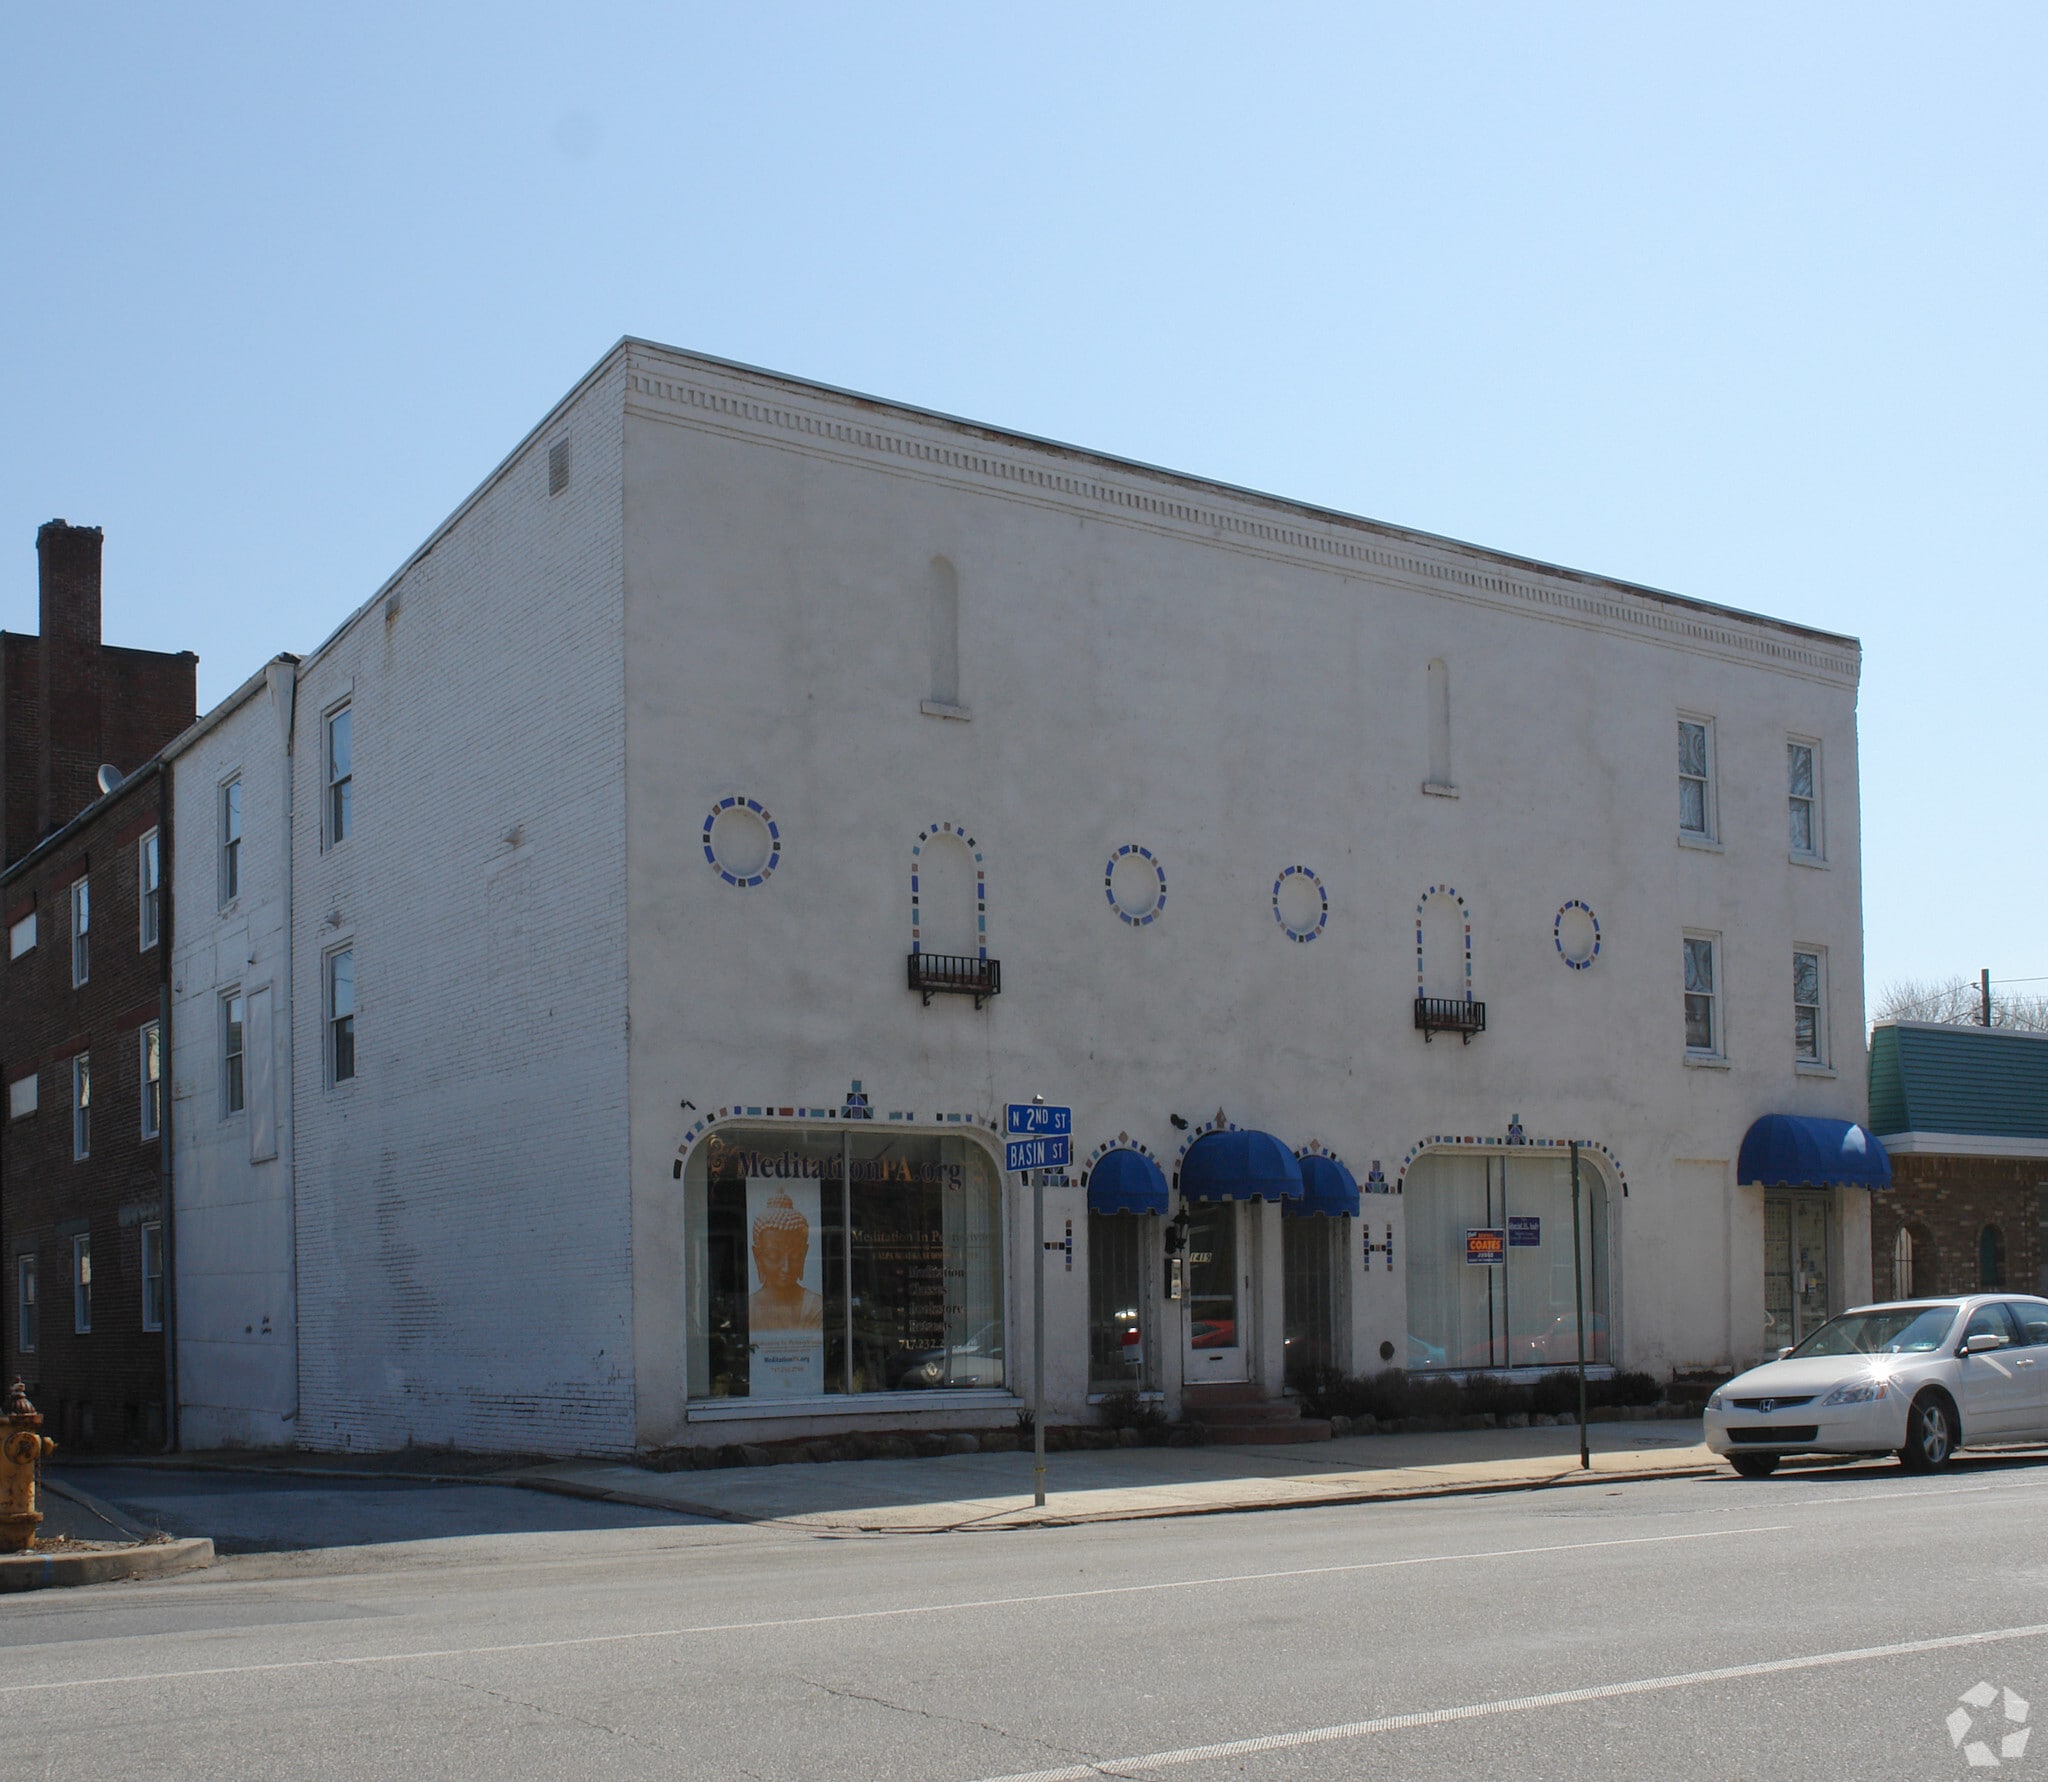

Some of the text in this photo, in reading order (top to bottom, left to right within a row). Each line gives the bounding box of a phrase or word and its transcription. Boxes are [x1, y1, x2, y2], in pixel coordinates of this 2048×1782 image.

[1012, 1108, 1066, 1131] N 2ND ST
[1010, 1141, 1063, 1168] BASIN ST
[738, 1150, 962, 1192] MeditationPA.org
[851, 1230, 913, 1243] Meditation
[916, 1230, 929, 1242] In
[1470, 1240, 1501, 1250] COATES
[1191, 1253, 1211, 1261] 1419
